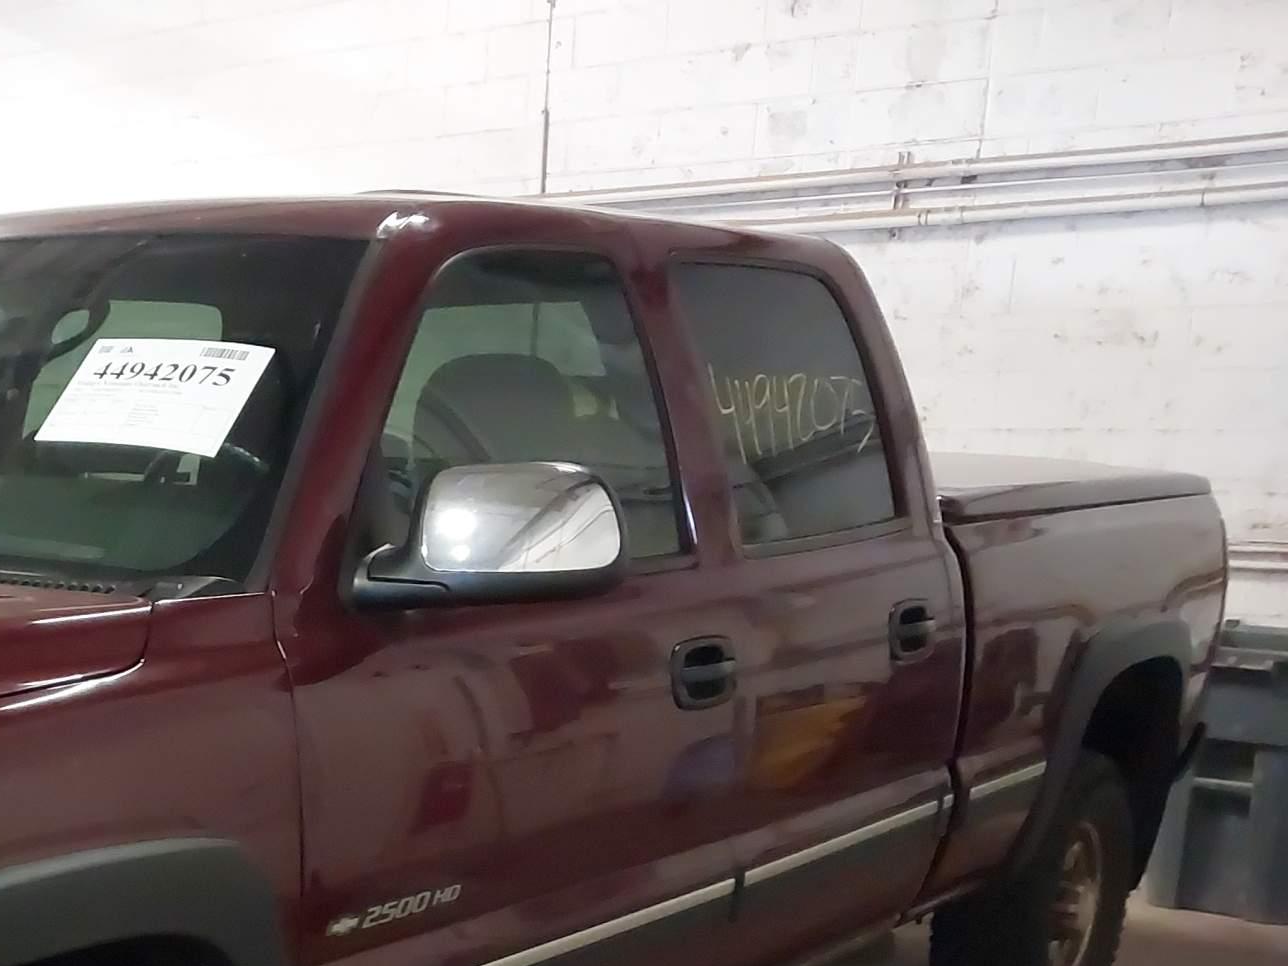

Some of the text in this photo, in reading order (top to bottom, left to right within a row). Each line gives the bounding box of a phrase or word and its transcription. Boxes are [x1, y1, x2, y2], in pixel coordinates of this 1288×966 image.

[93, 361, 237, 387] 44942075
[362, 884, 462, 929] 2500 HD
